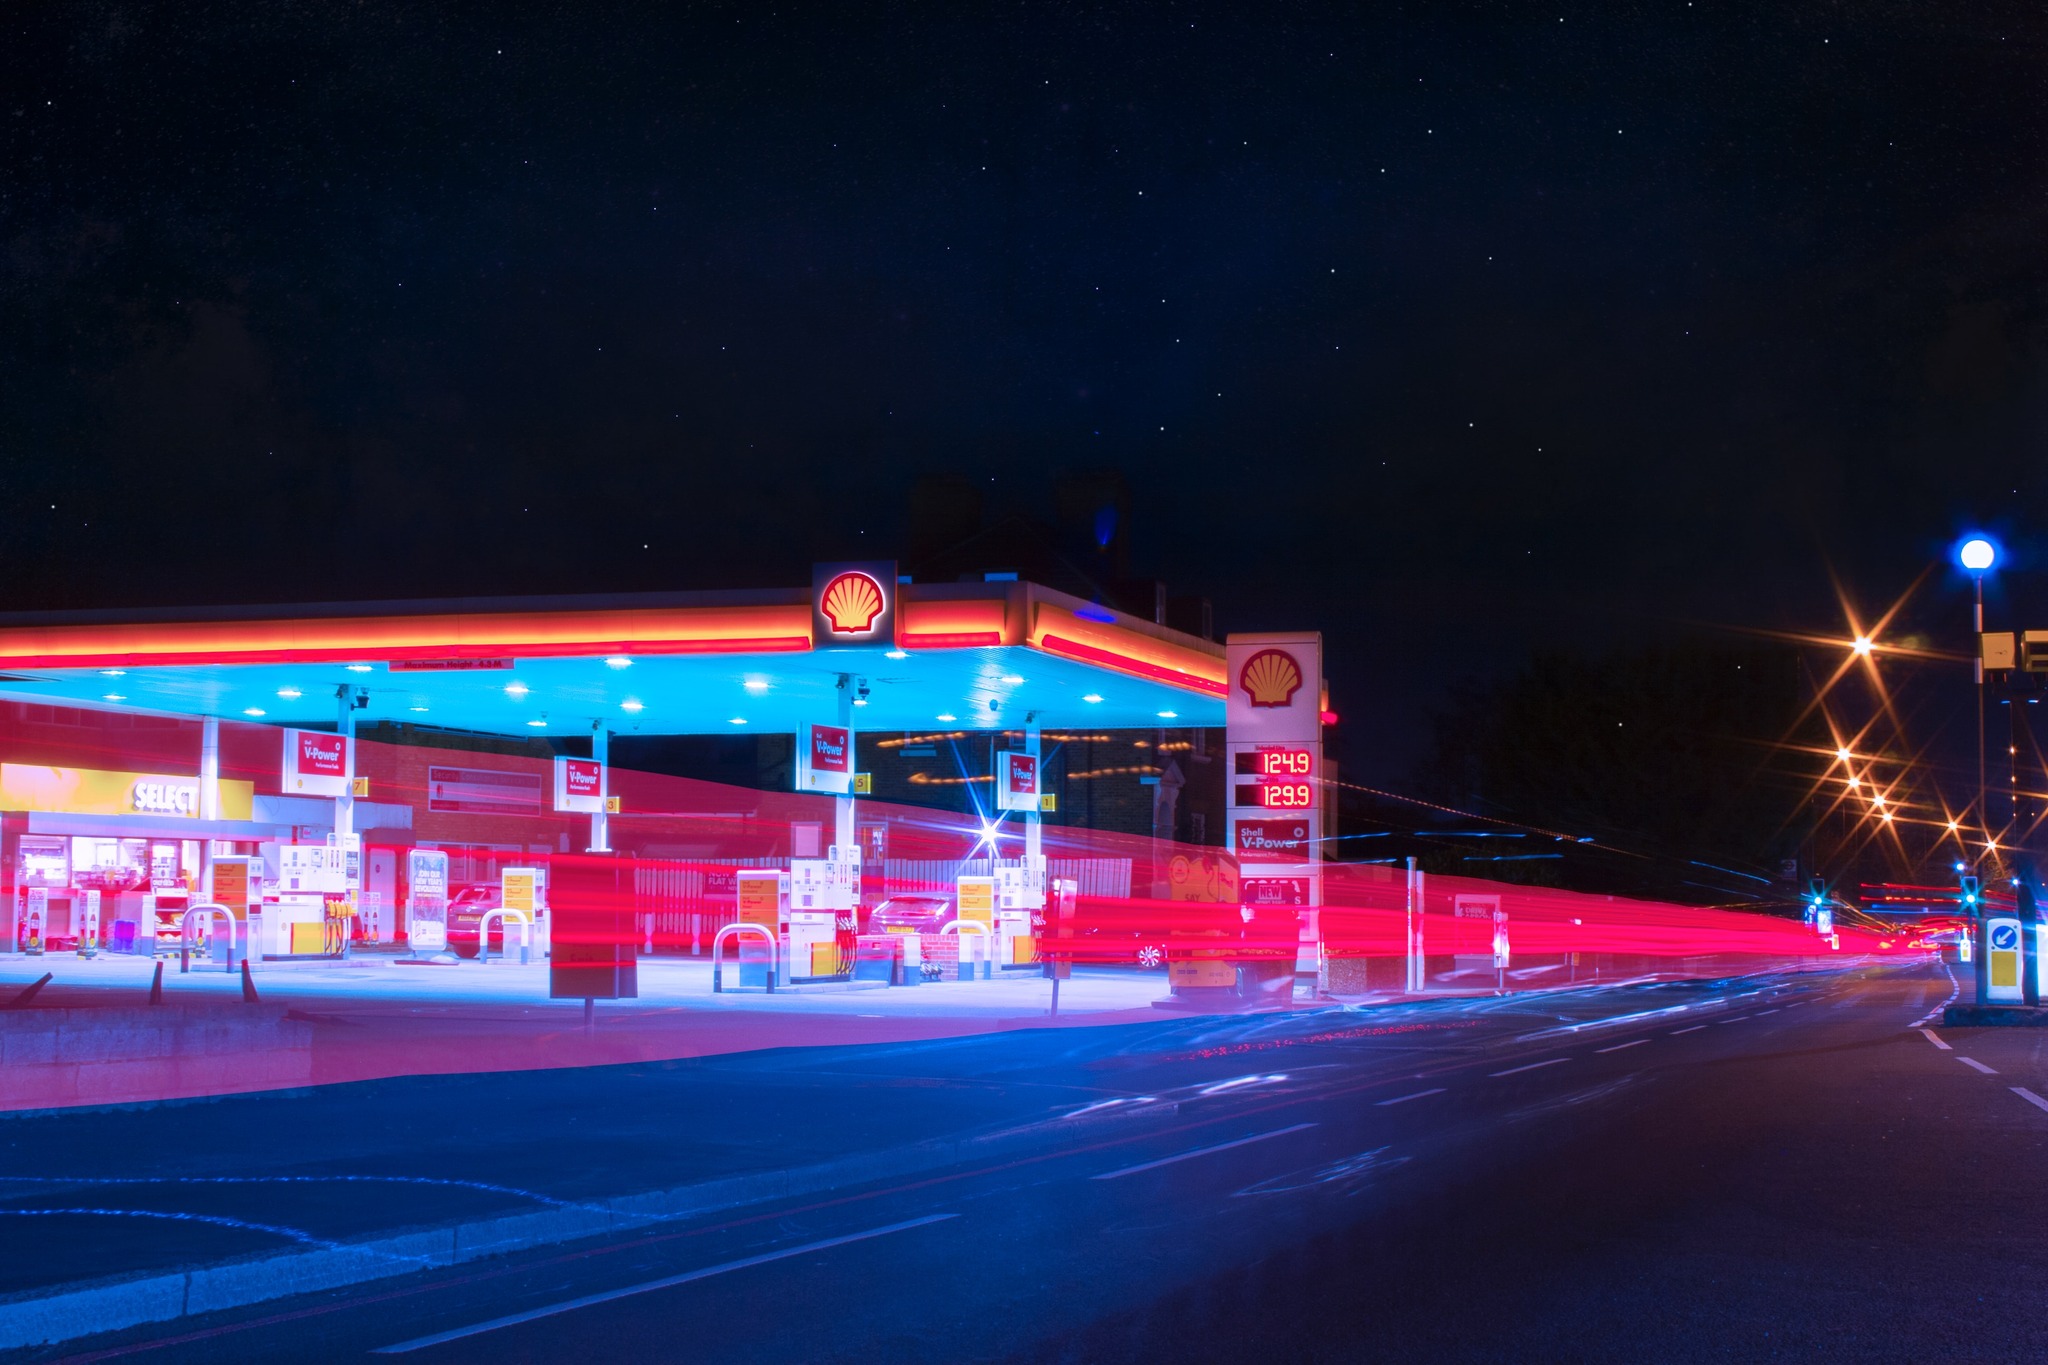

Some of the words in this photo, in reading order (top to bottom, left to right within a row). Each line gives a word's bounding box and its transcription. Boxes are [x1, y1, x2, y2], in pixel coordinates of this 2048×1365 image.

[404, 661, 445, 669] Maximum
[446, 660, 473, 670] Height
[304, 747, 339, 761] V-Power
[816, 740, 843, 756] V-Power
[1264, 753, 1309, 774] 124.9
[569, 771, 597, 784] V-Power
[857, 778, 864, 788] 5
[354, 781, 361, 791] 7
[133, 782, 198, 812] SELECT
[1264, 785, 1309, 806] 129.9
[608, 800, 614, 810] 3
[1241, 828, 1264, 837] Shell
[1241, 837, 1299, 849] V-Power
[708, 877, 726, 885] FLAT
[1260, 886, 1281, 898] NEW
